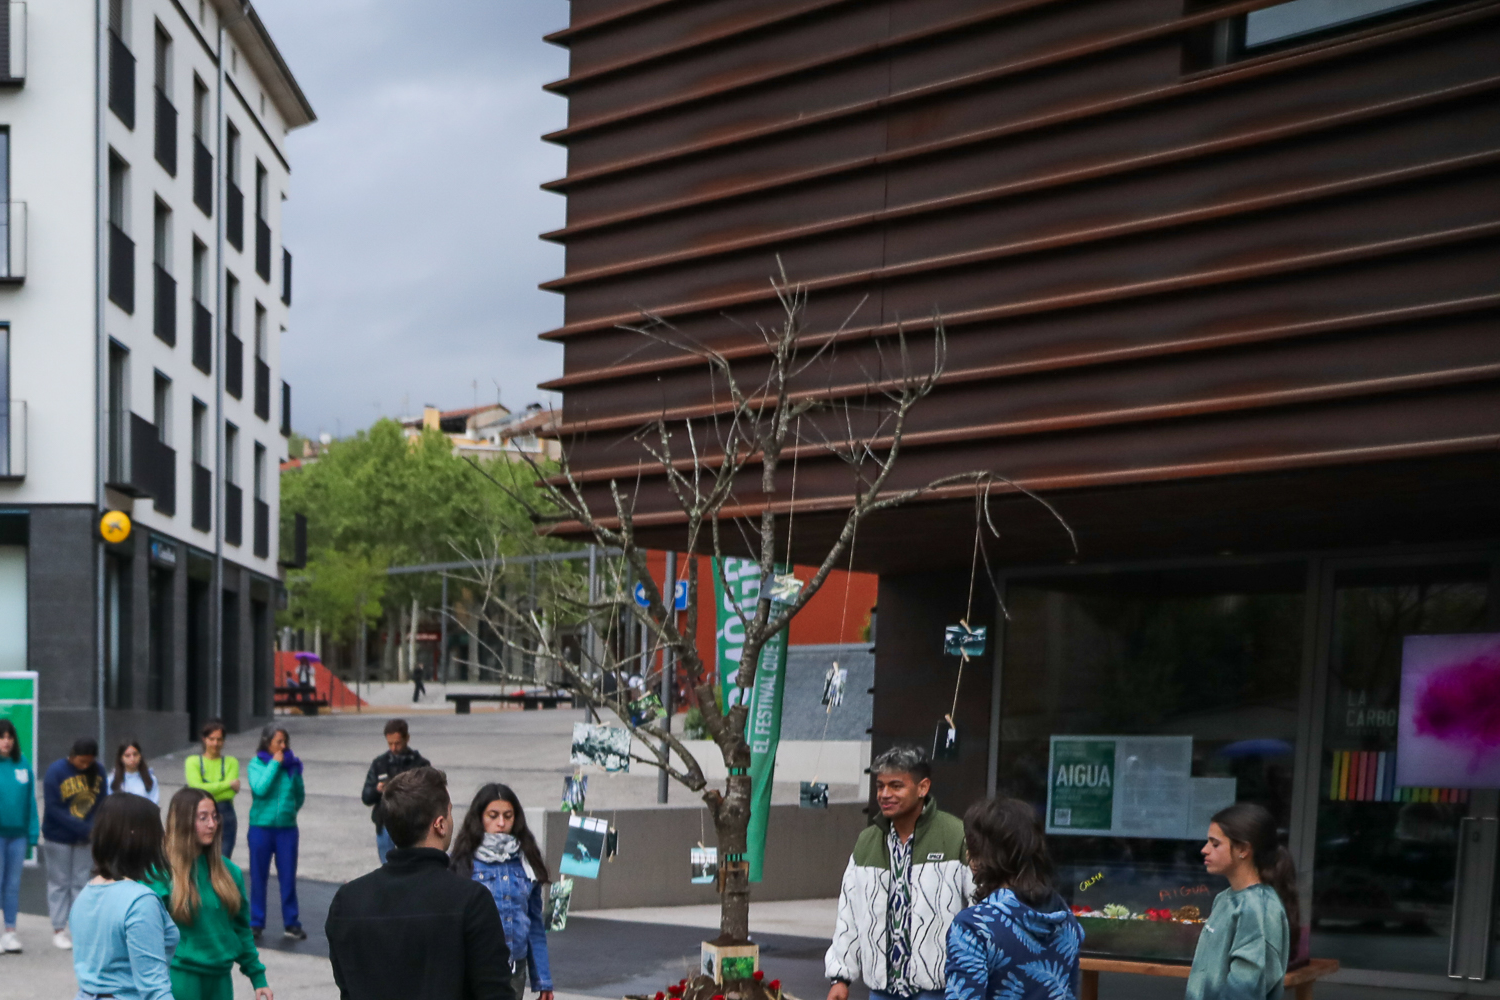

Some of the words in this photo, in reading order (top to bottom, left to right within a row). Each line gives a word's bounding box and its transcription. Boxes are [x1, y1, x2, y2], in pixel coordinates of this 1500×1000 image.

[762, 644, 780, 672] QUE
[755, 674, 777, 735] FESTIVAL
[753, 738, 770, 754] EL
[1056, 763, 1111, 788] AIGUA
[1159, 884, 1210, 902] AIGUA
